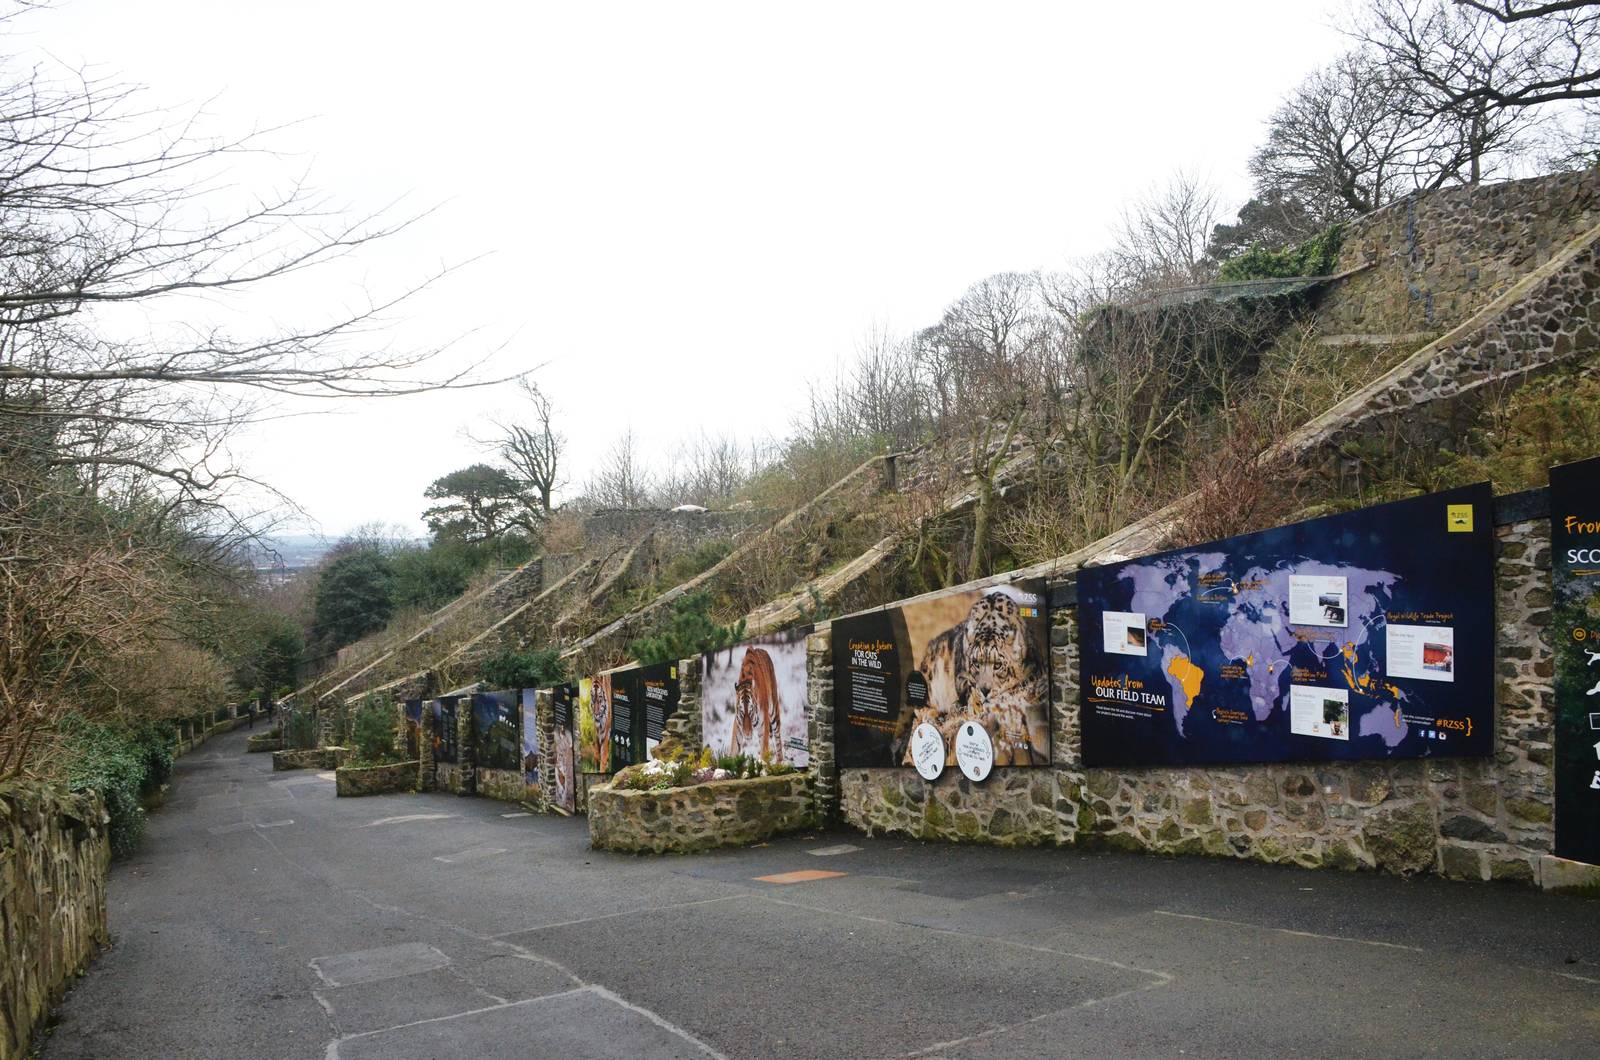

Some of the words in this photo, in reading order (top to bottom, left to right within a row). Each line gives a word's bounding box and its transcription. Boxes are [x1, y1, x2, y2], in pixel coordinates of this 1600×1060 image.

[854, 649, 865, 658] FOR
[864, 650, 878, 660] CATS
[851, 657, 858, 665] IN
[858, 658, 868, 667] THE
[868, 659, 882, 669] WILD
[1091, 675, 1121, 688] Updates
[1123, 674, 1143, 691] from
[1095, 687, 1115, 699] OUR
[1116, 688, 1139, 702] FIELD
[1140, 692, 1166, 706] TEAM
